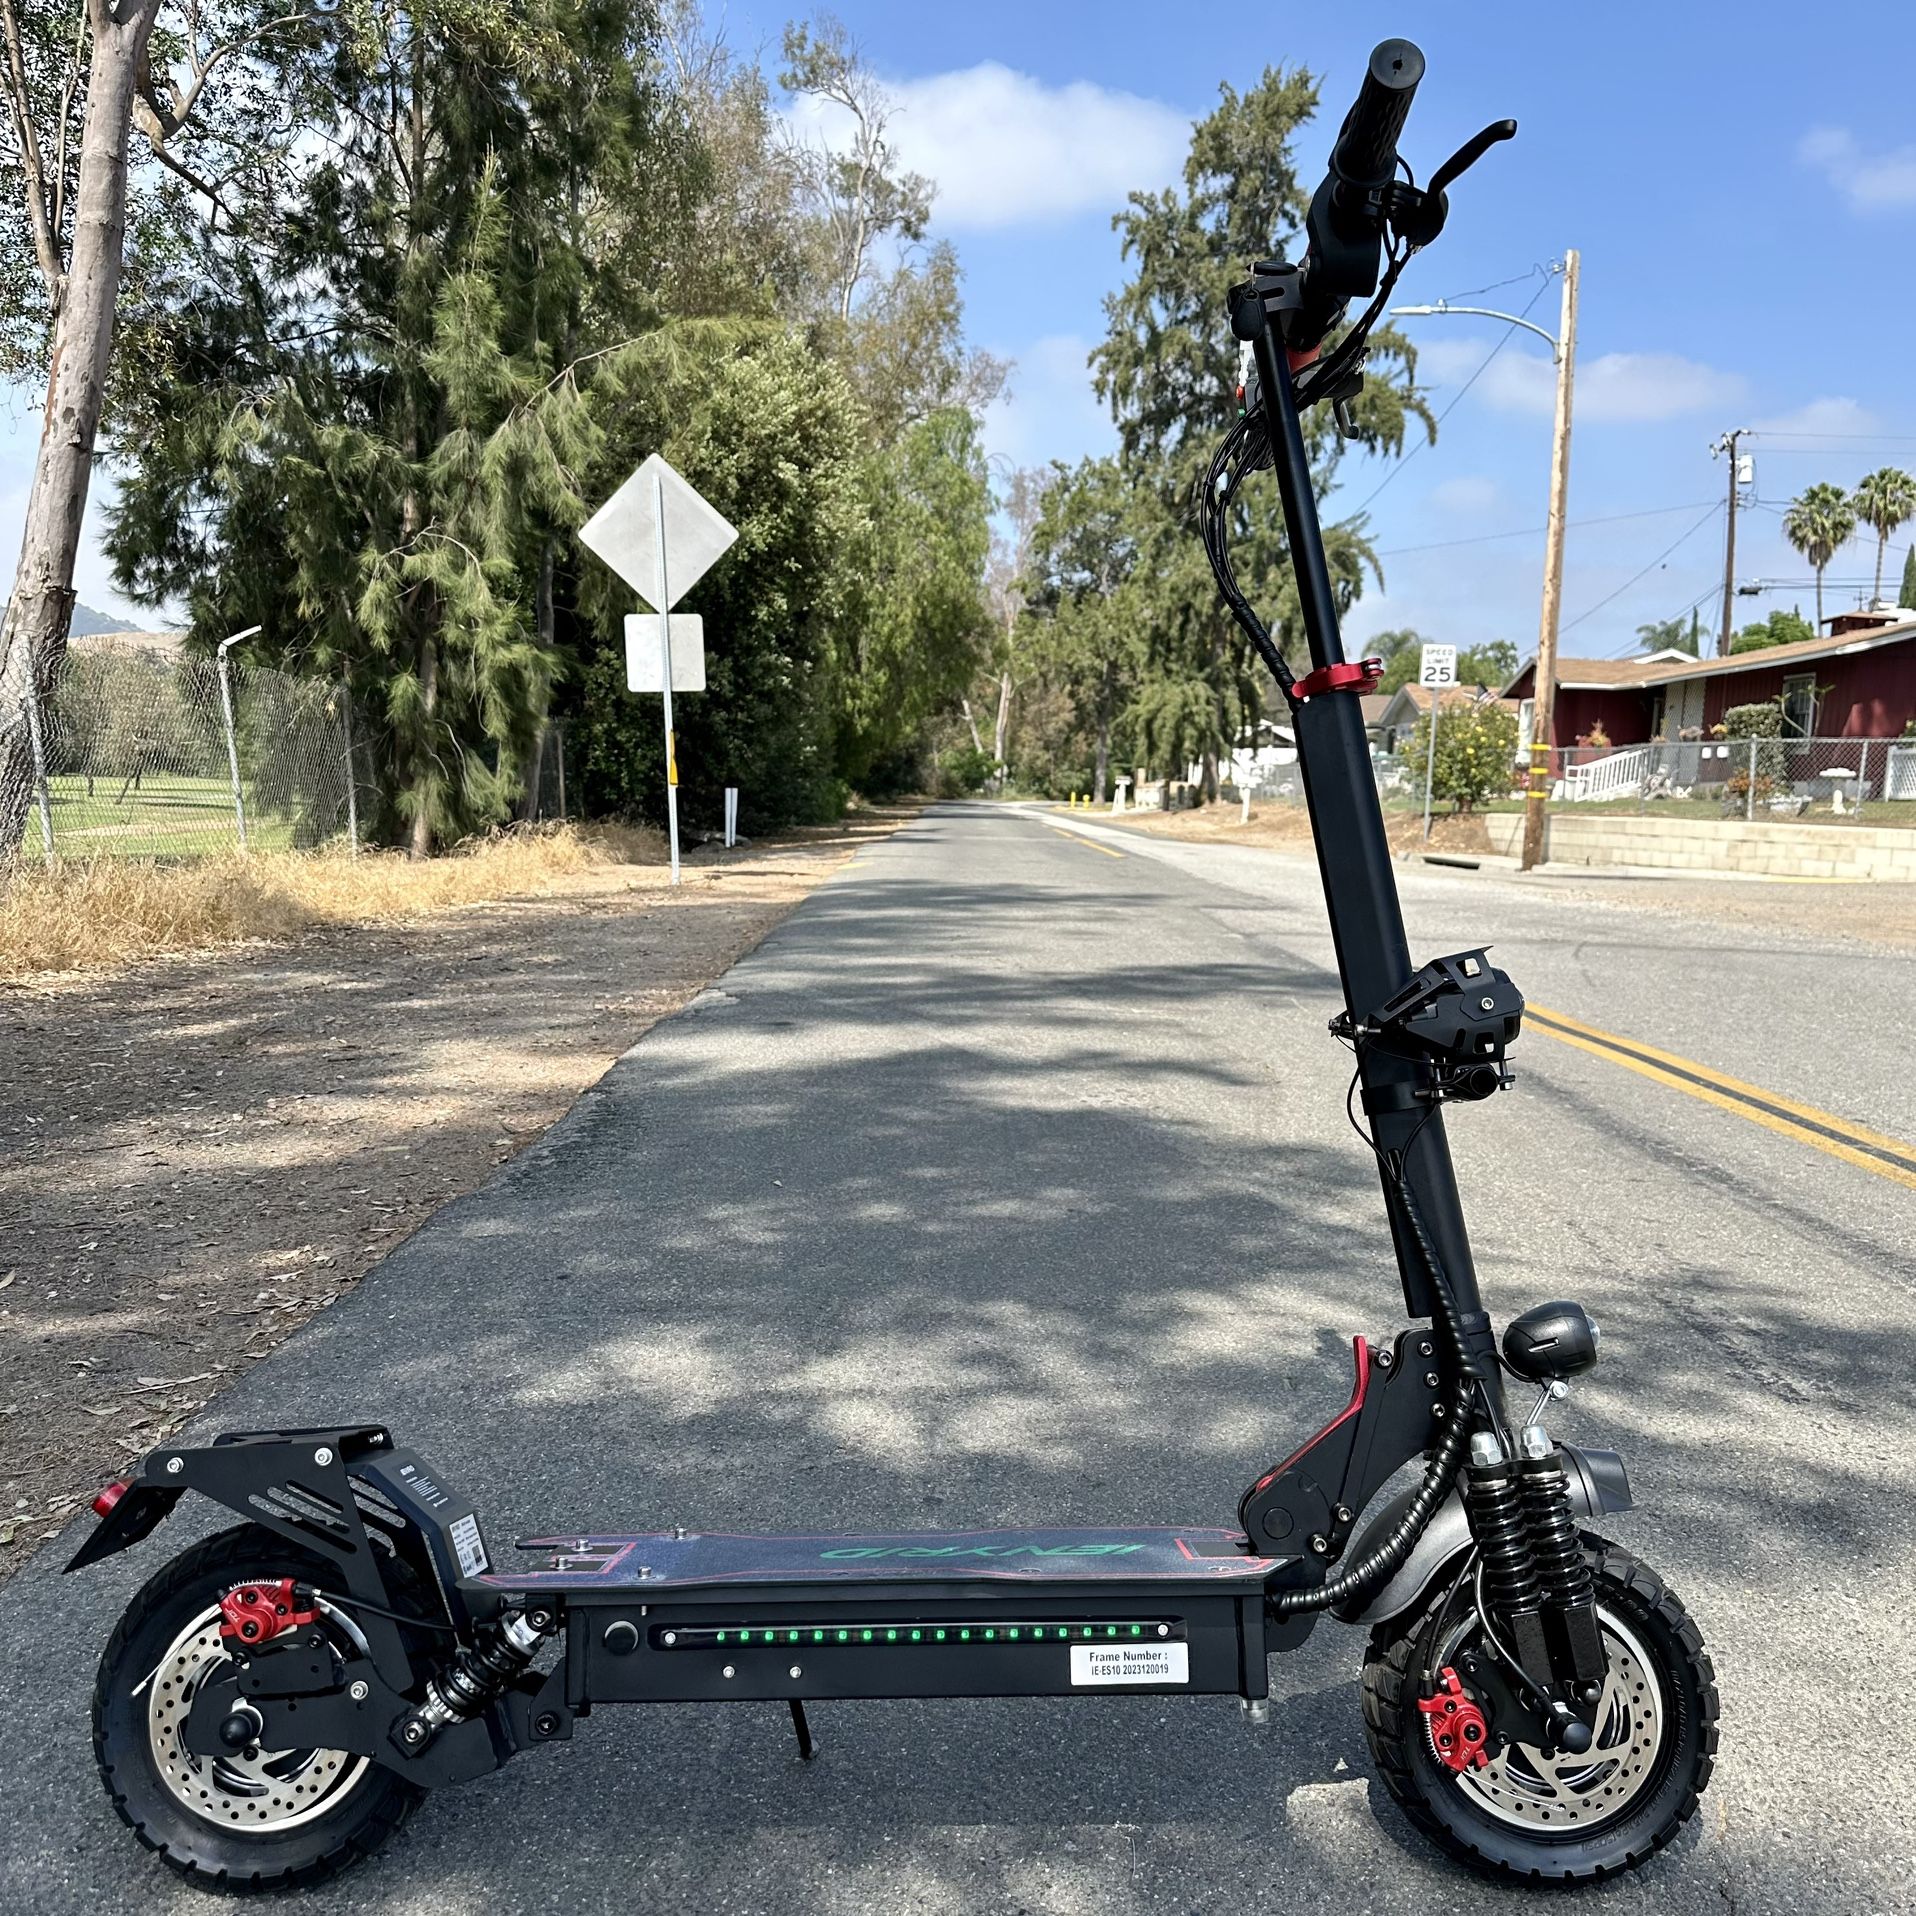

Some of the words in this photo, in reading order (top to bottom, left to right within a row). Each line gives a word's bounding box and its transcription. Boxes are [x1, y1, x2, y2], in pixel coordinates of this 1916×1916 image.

[1426, 648, 1454, 656] SPEED
[1424, 666, 1451, 682] 25
[820, 1544, 1147, 1558] IENYRID
[1089, 1652, 1120, 1662] Frame
[1123, 1651, 1162, 1661] Number
[1122, 1664, 1169, 1675] 2023120019
